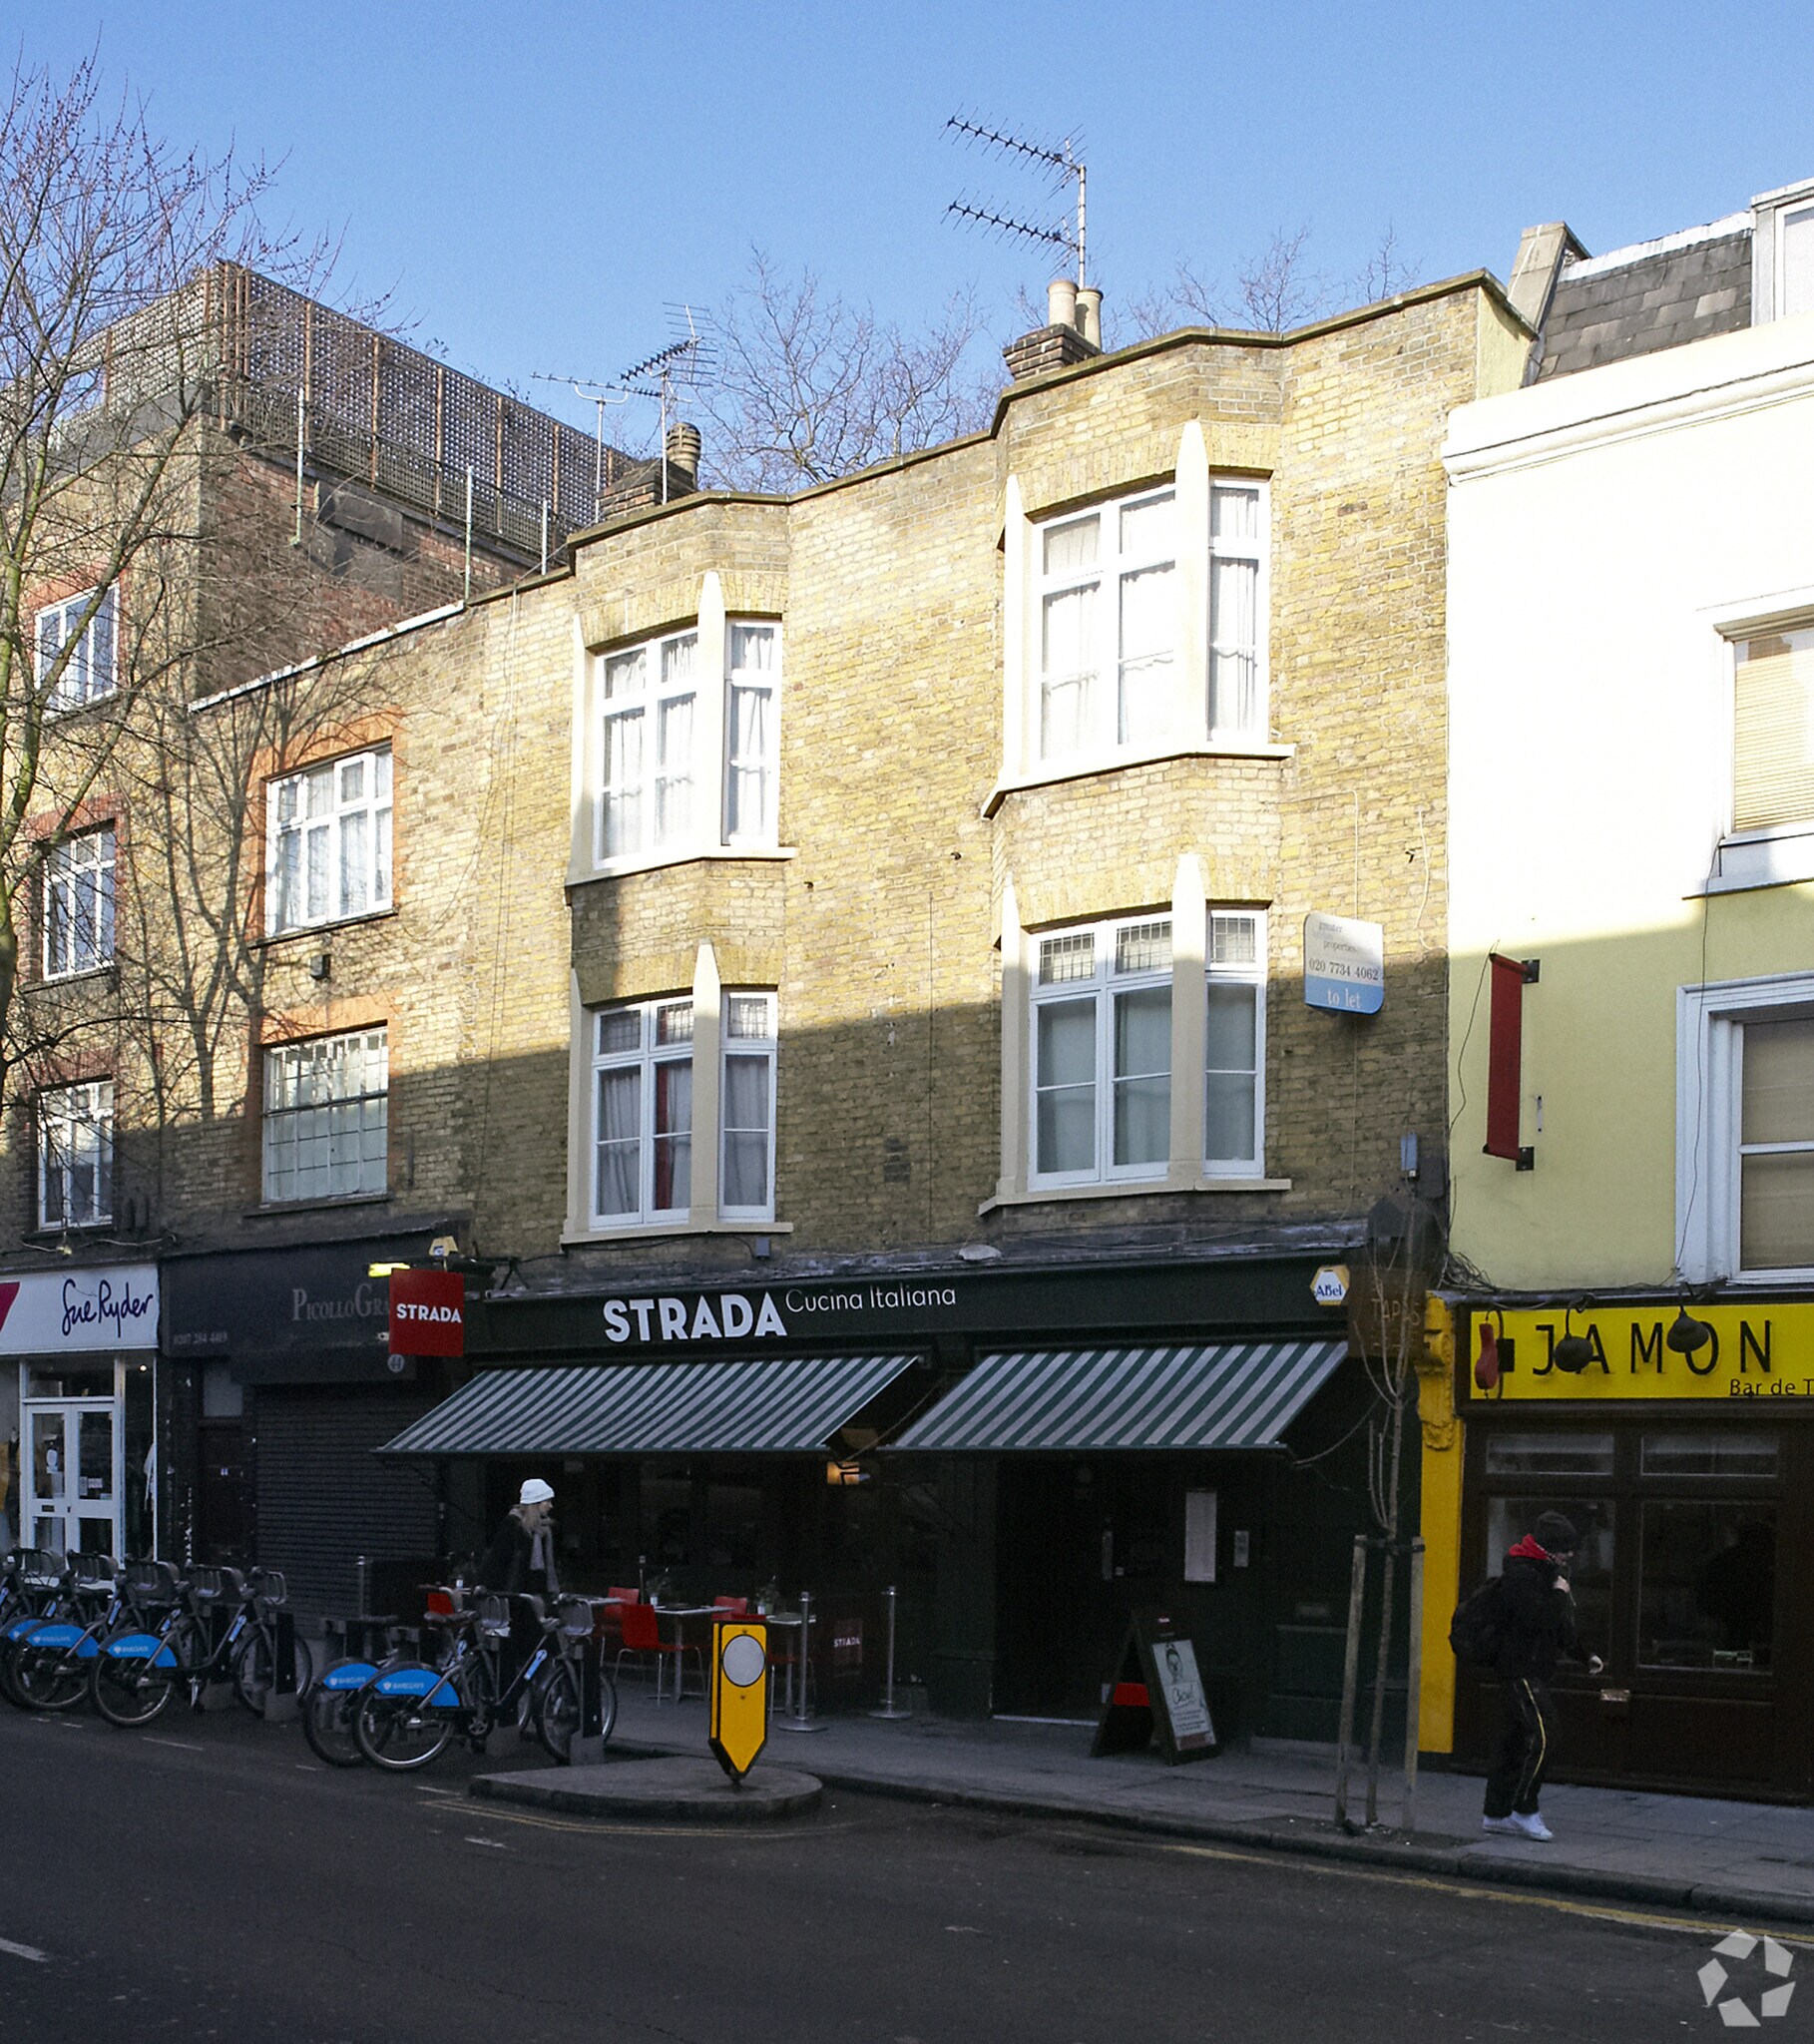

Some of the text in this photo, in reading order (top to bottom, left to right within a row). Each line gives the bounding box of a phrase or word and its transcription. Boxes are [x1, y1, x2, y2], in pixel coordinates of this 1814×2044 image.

[1309, 958, 1379, 981] 020 7734 4062
[1327, 988, 1361, 1009] to let
[62, 1278, 154, 1338] Sue Ryder
[785, 1282, 957, 1313] Cucina Italiana
[396, 1302, 462, 1323] STRADA
[603, 1292, 787, 1342] STRADA
[1533, 1320, 1772, 1376] JAMON
[1730, 1378, 1762, 1396] Bar
[1770, 1378, 1796, 1396] de
